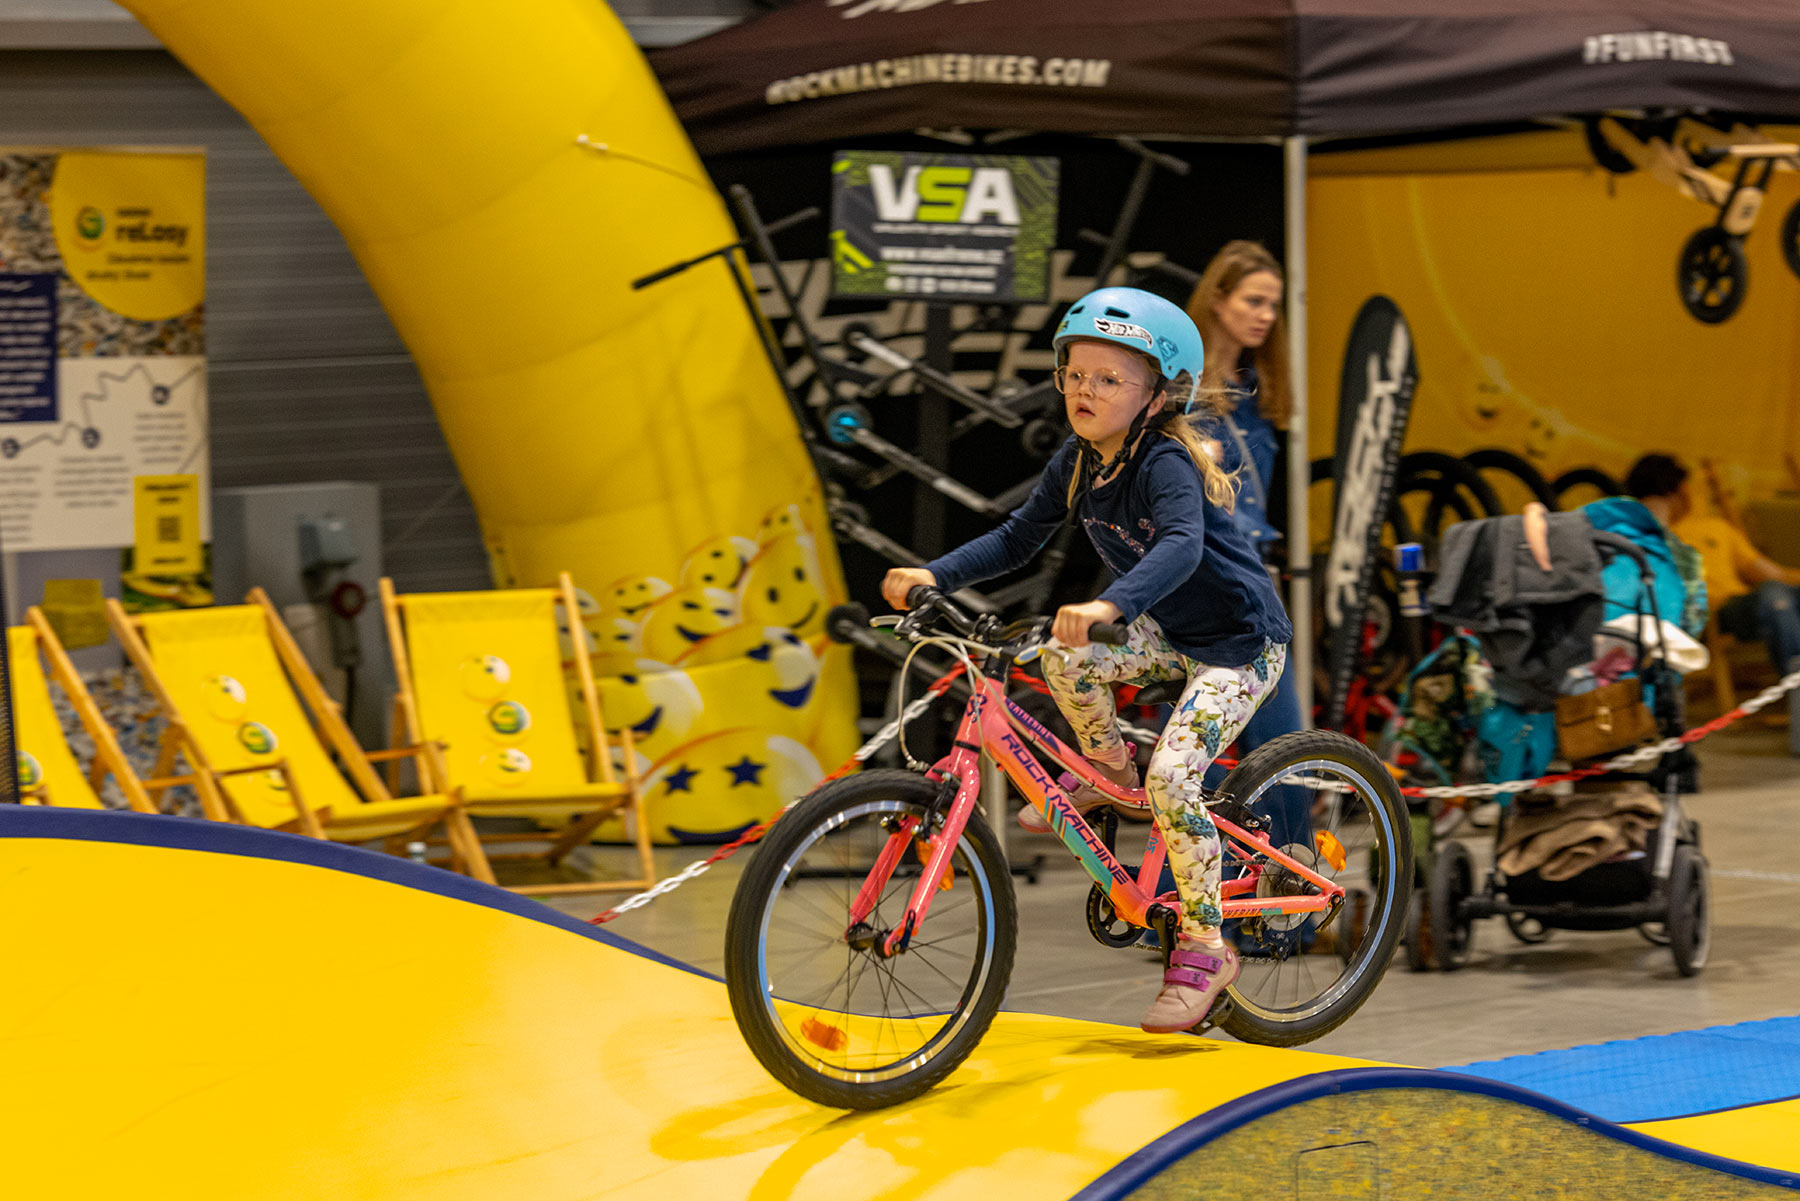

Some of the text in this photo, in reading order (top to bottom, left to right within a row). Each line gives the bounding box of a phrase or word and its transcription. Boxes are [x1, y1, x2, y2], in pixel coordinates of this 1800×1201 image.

[868, 164, 1021, 225] VSA
[1001, 733, 1129, 886] ROCK MACHINE
